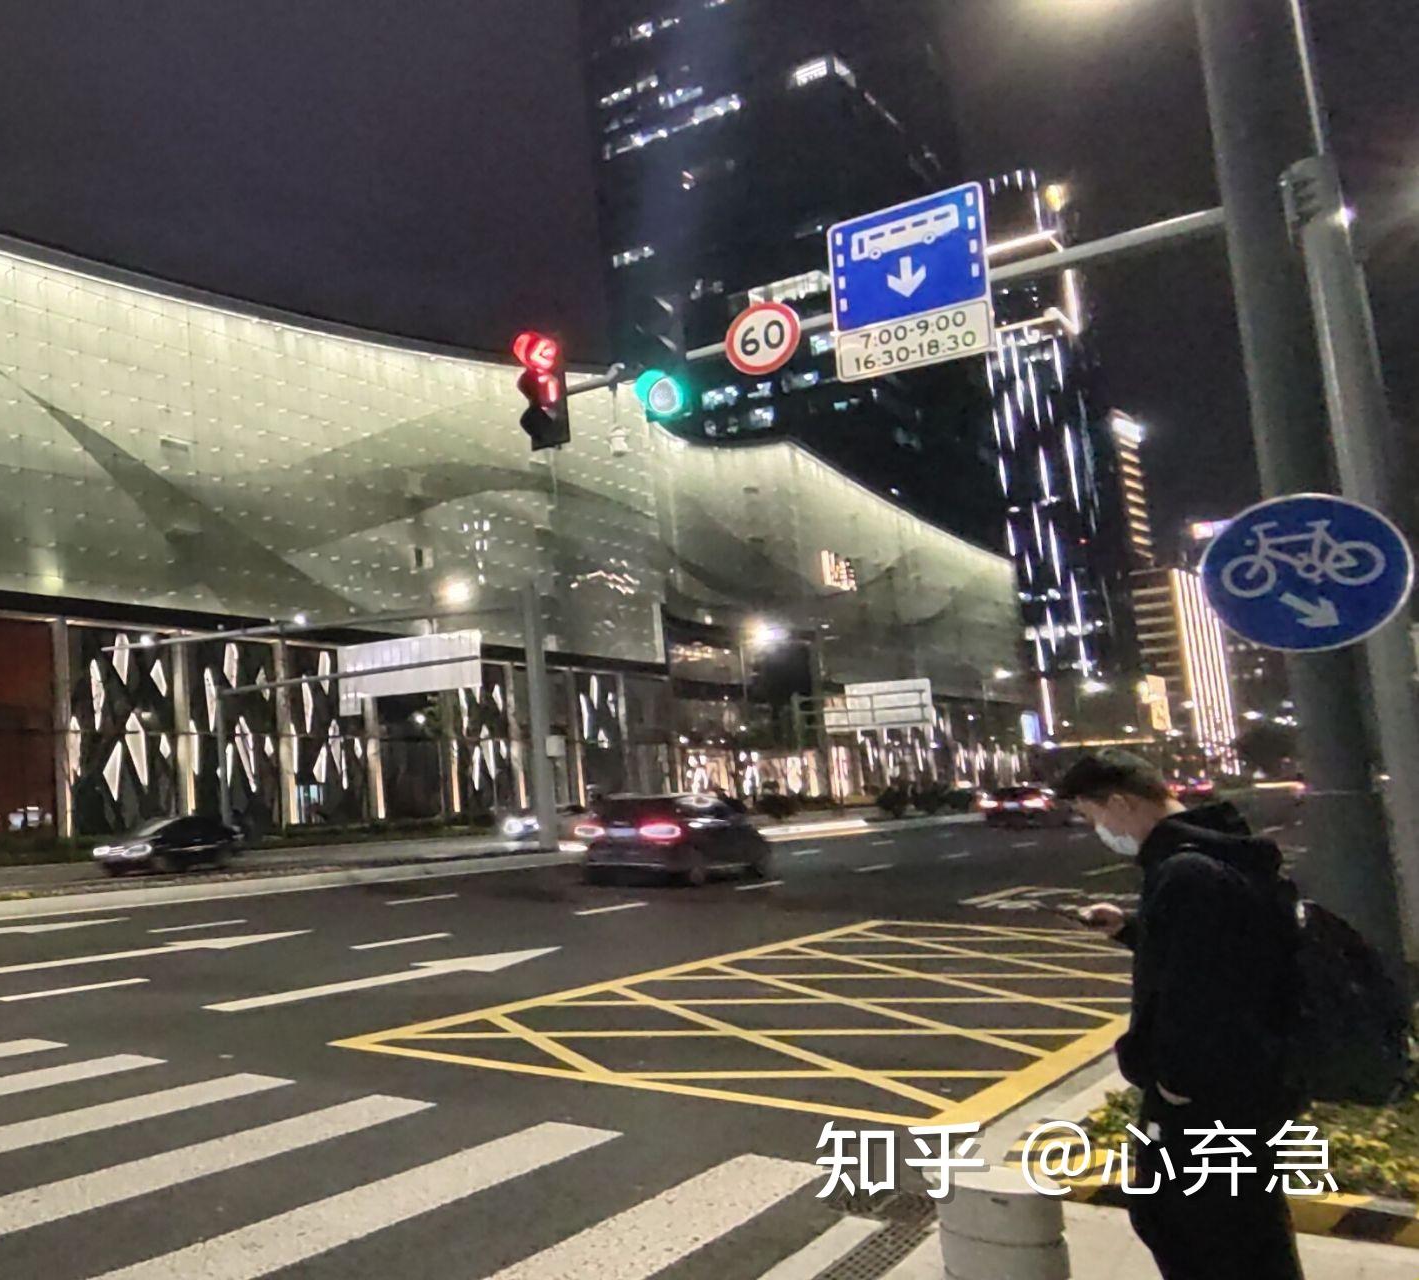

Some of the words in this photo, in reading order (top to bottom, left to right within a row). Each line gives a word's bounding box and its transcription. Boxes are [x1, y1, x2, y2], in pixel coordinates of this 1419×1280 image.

[740, 320, 785, 357] 60
[859, 310, 966, 350] 7:00-9:00
[854, 330, 976, 372] 16:30-18:30
